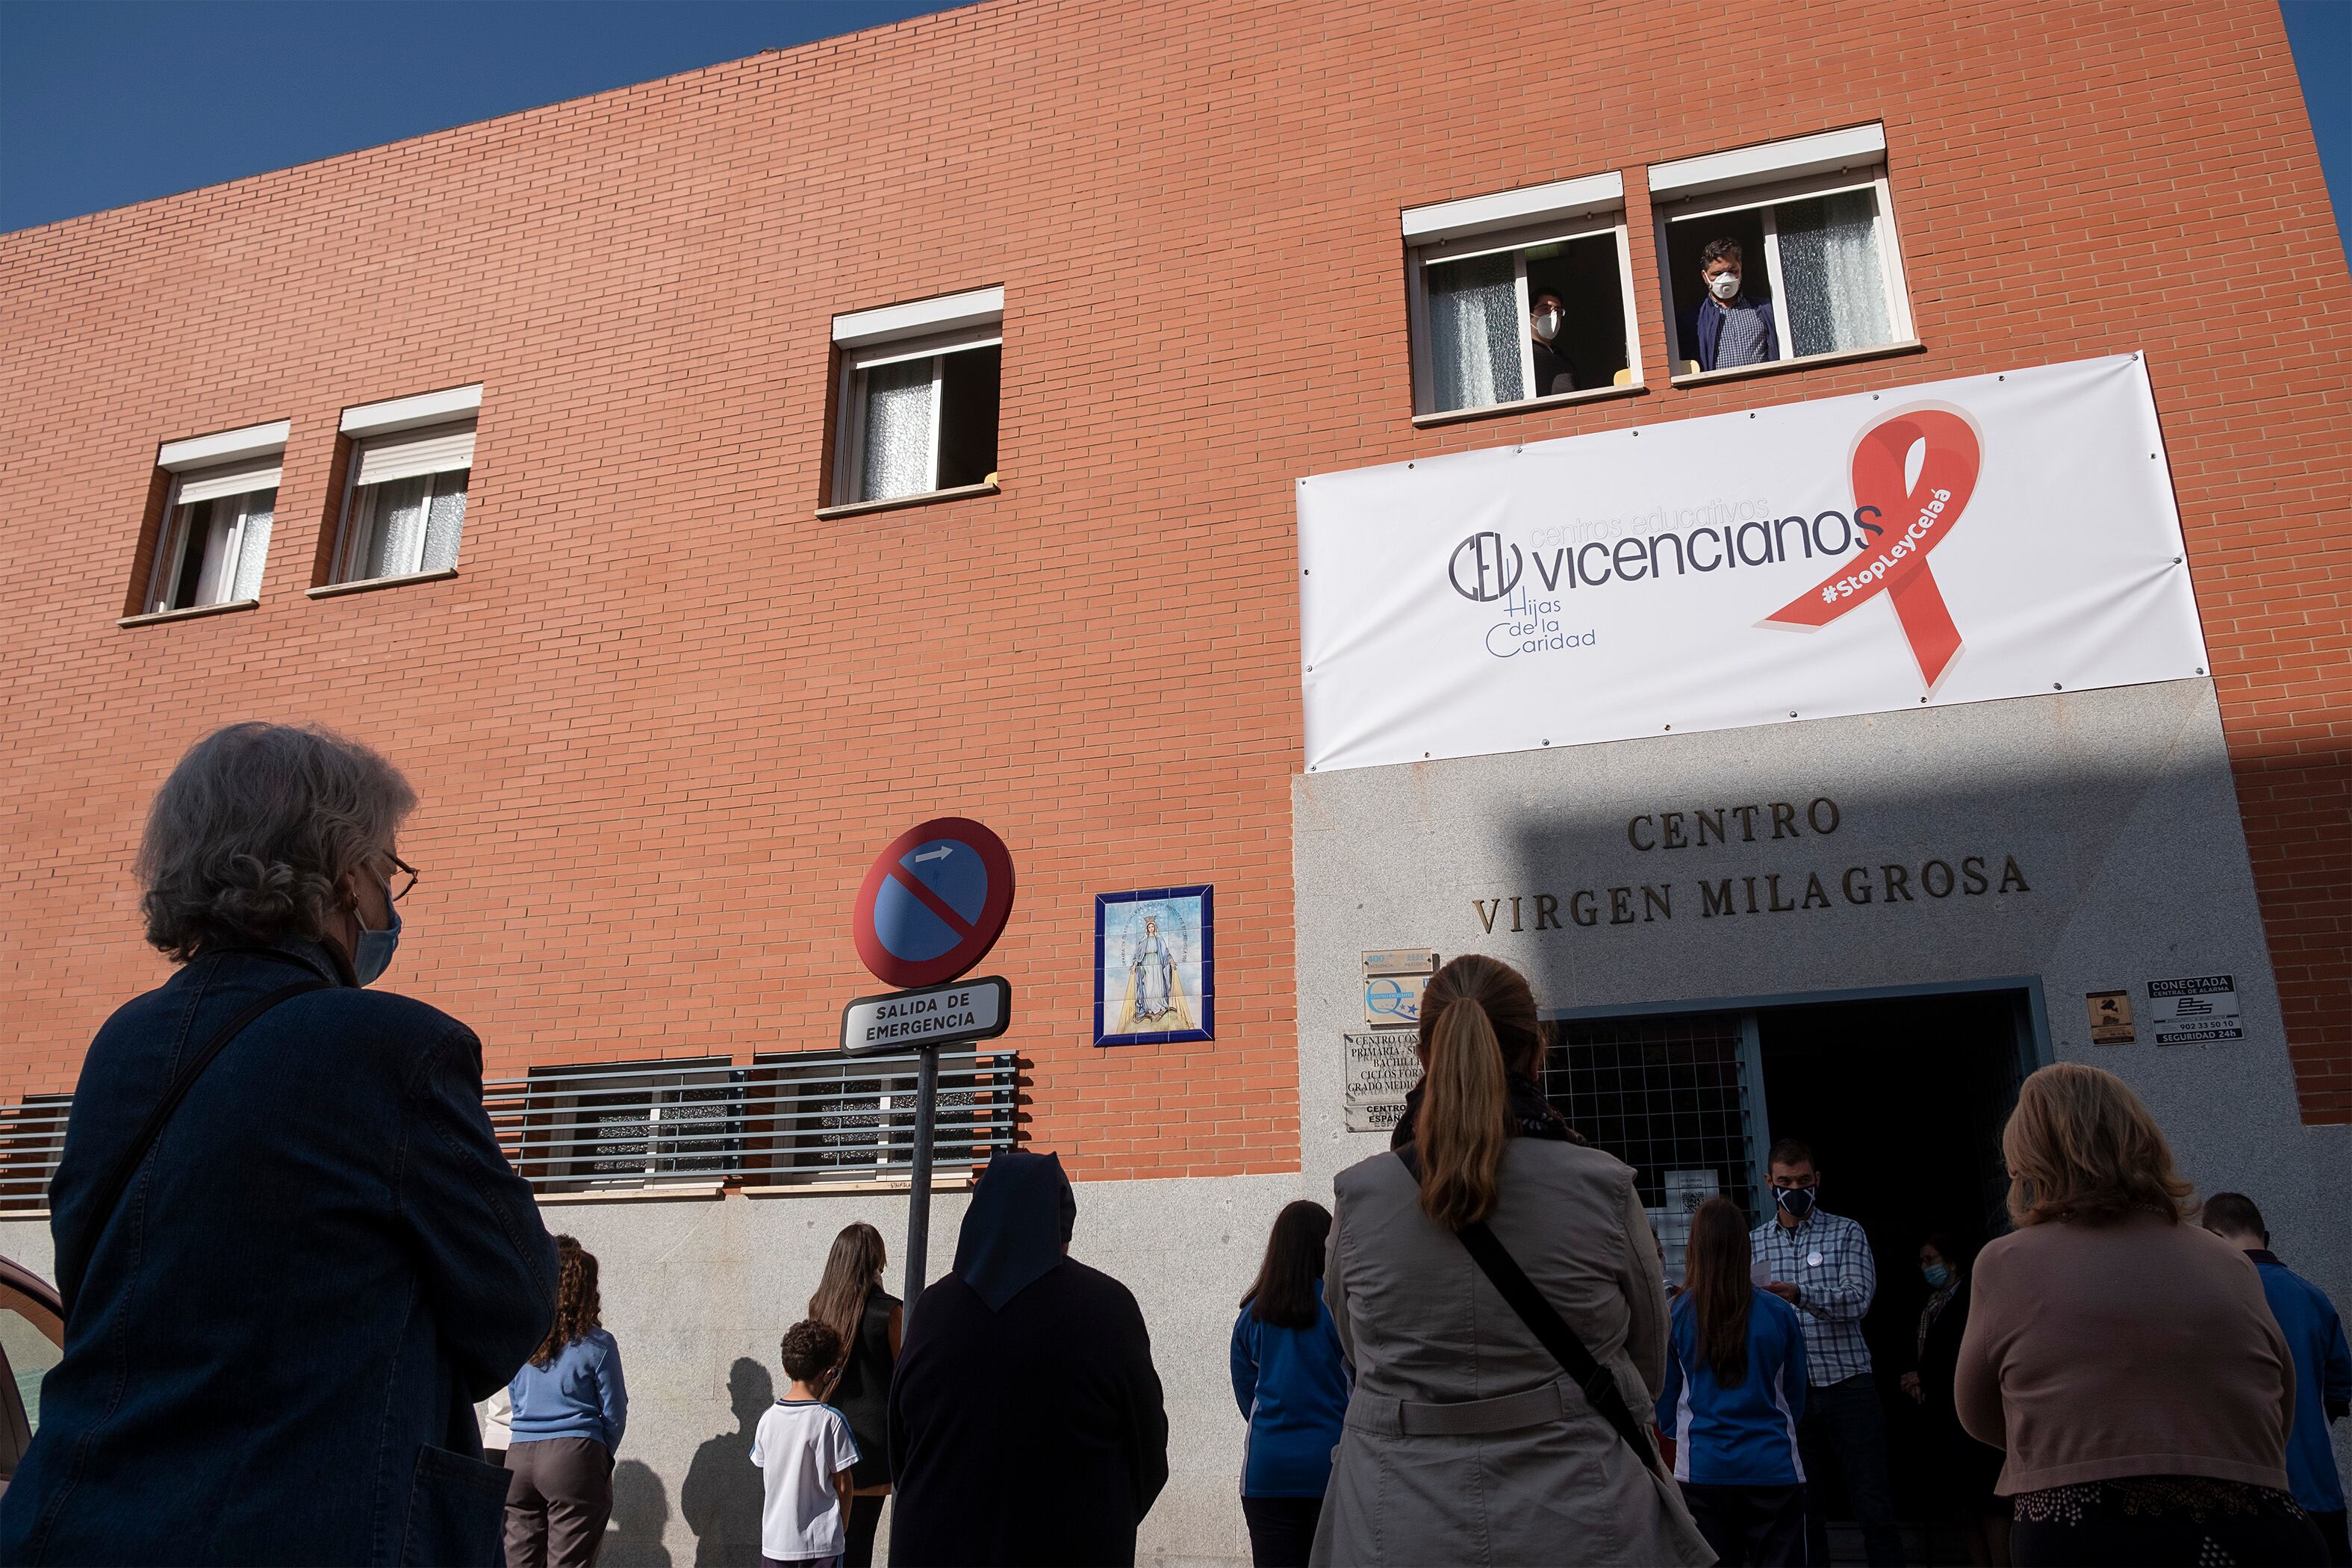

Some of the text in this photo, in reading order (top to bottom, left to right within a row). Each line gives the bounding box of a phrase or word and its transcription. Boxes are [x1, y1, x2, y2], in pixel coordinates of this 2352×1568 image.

[1529, 496, 1769, 549] centros educativos
[1532, 505, 1885, 592] vicencianos
[1820, 488, 1952, 604] #StopLeyCelaá
[1503, 558, 1562, 627] Hijas
[1486, 622, 1596, 658] Caridad
[1509, 618, 1559, 637] de la
[1627, 796, 1841, 851] CENTRO
[1472, 853, 2031, 934] VIRGEN MILAGROSA
[2152, 977, 2228, 991] CONECTADA
[875, 992, 969, 1020] SALIDA DE
[865, 1011, 975, 1041] EMERGENCIA
[1356, 1034, 1419, 1045] CENTRO CON
[2162, 1030, 2236, 1042] SEGURIDAD 24h
[1351, 1046, 1400, 1057] PRIMARIA
[1348, 1080, 1417, 1092] GRADO MEDIO
[1360, 1069, 1397, 1080] CICLOS
[1366, 1104, 1406, 1113] CENTRO
